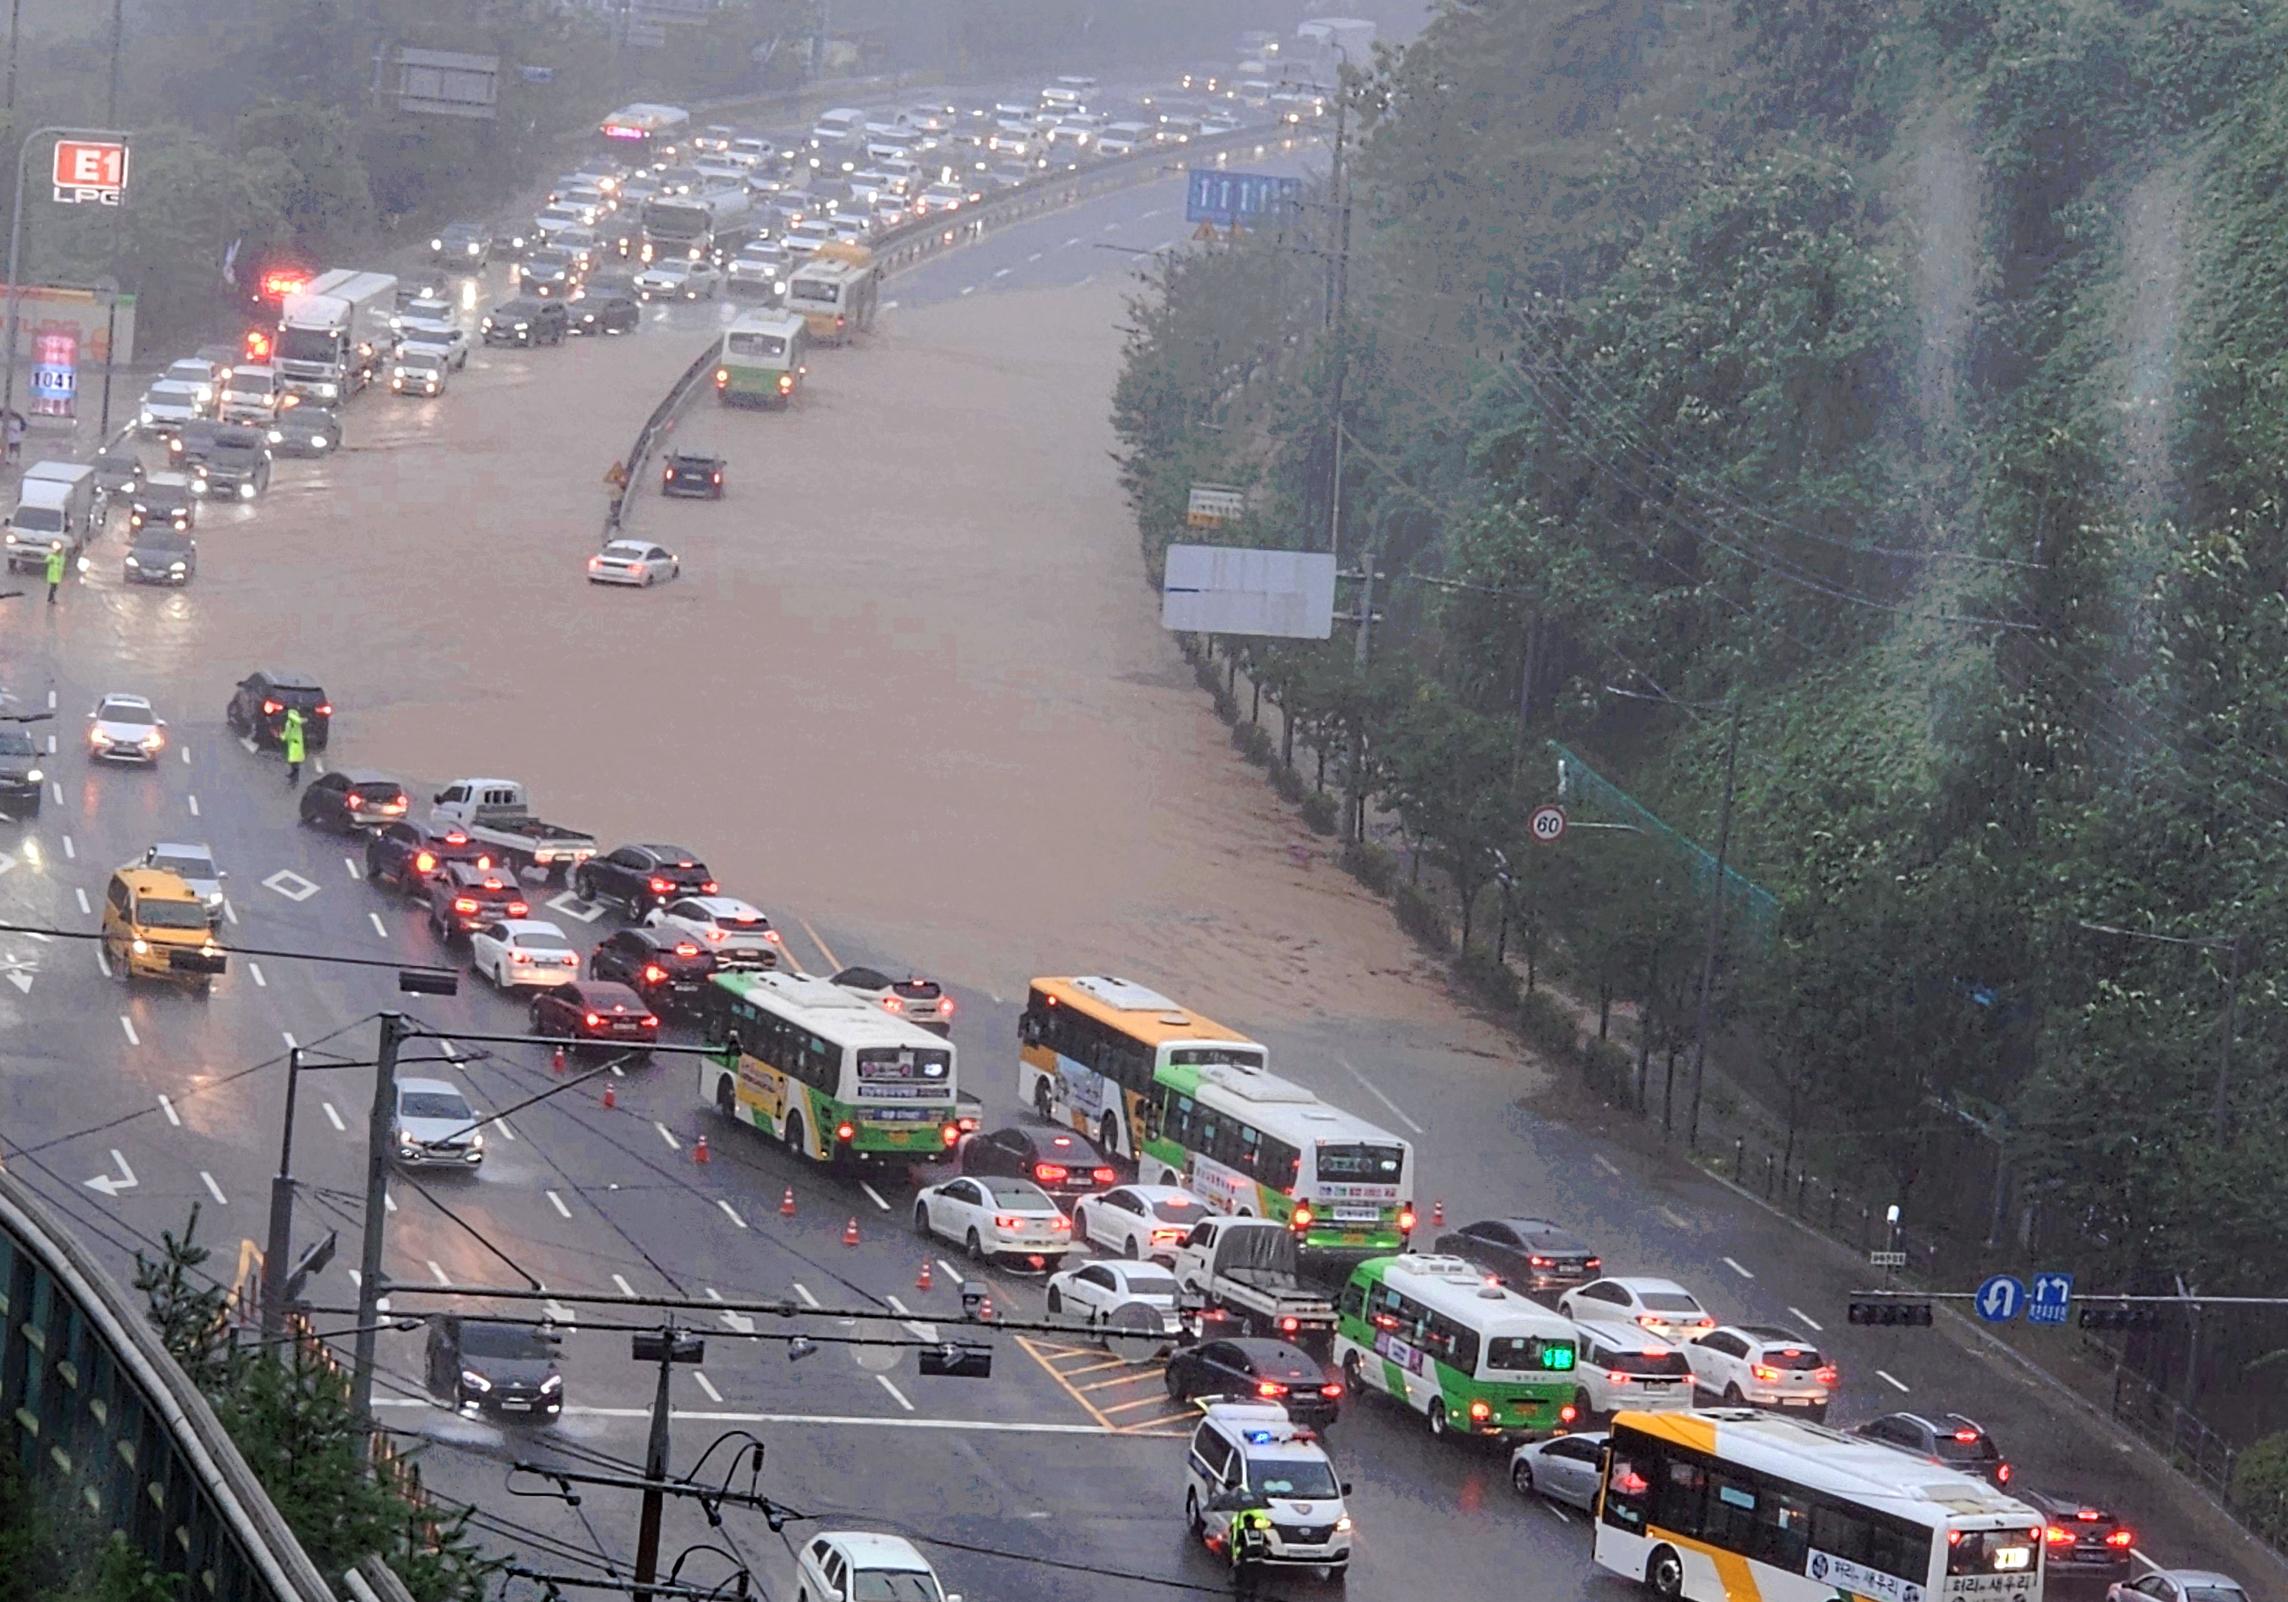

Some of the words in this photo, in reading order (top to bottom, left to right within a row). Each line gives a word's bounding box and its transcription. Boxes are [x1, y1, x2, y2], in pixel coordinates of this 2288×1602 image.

[74, 149, 121, 182] E1
[53, 187, 121, 206] LPG
[33, 371, 74, 389] 1041
[1537, 816, 1559, 833] 60
